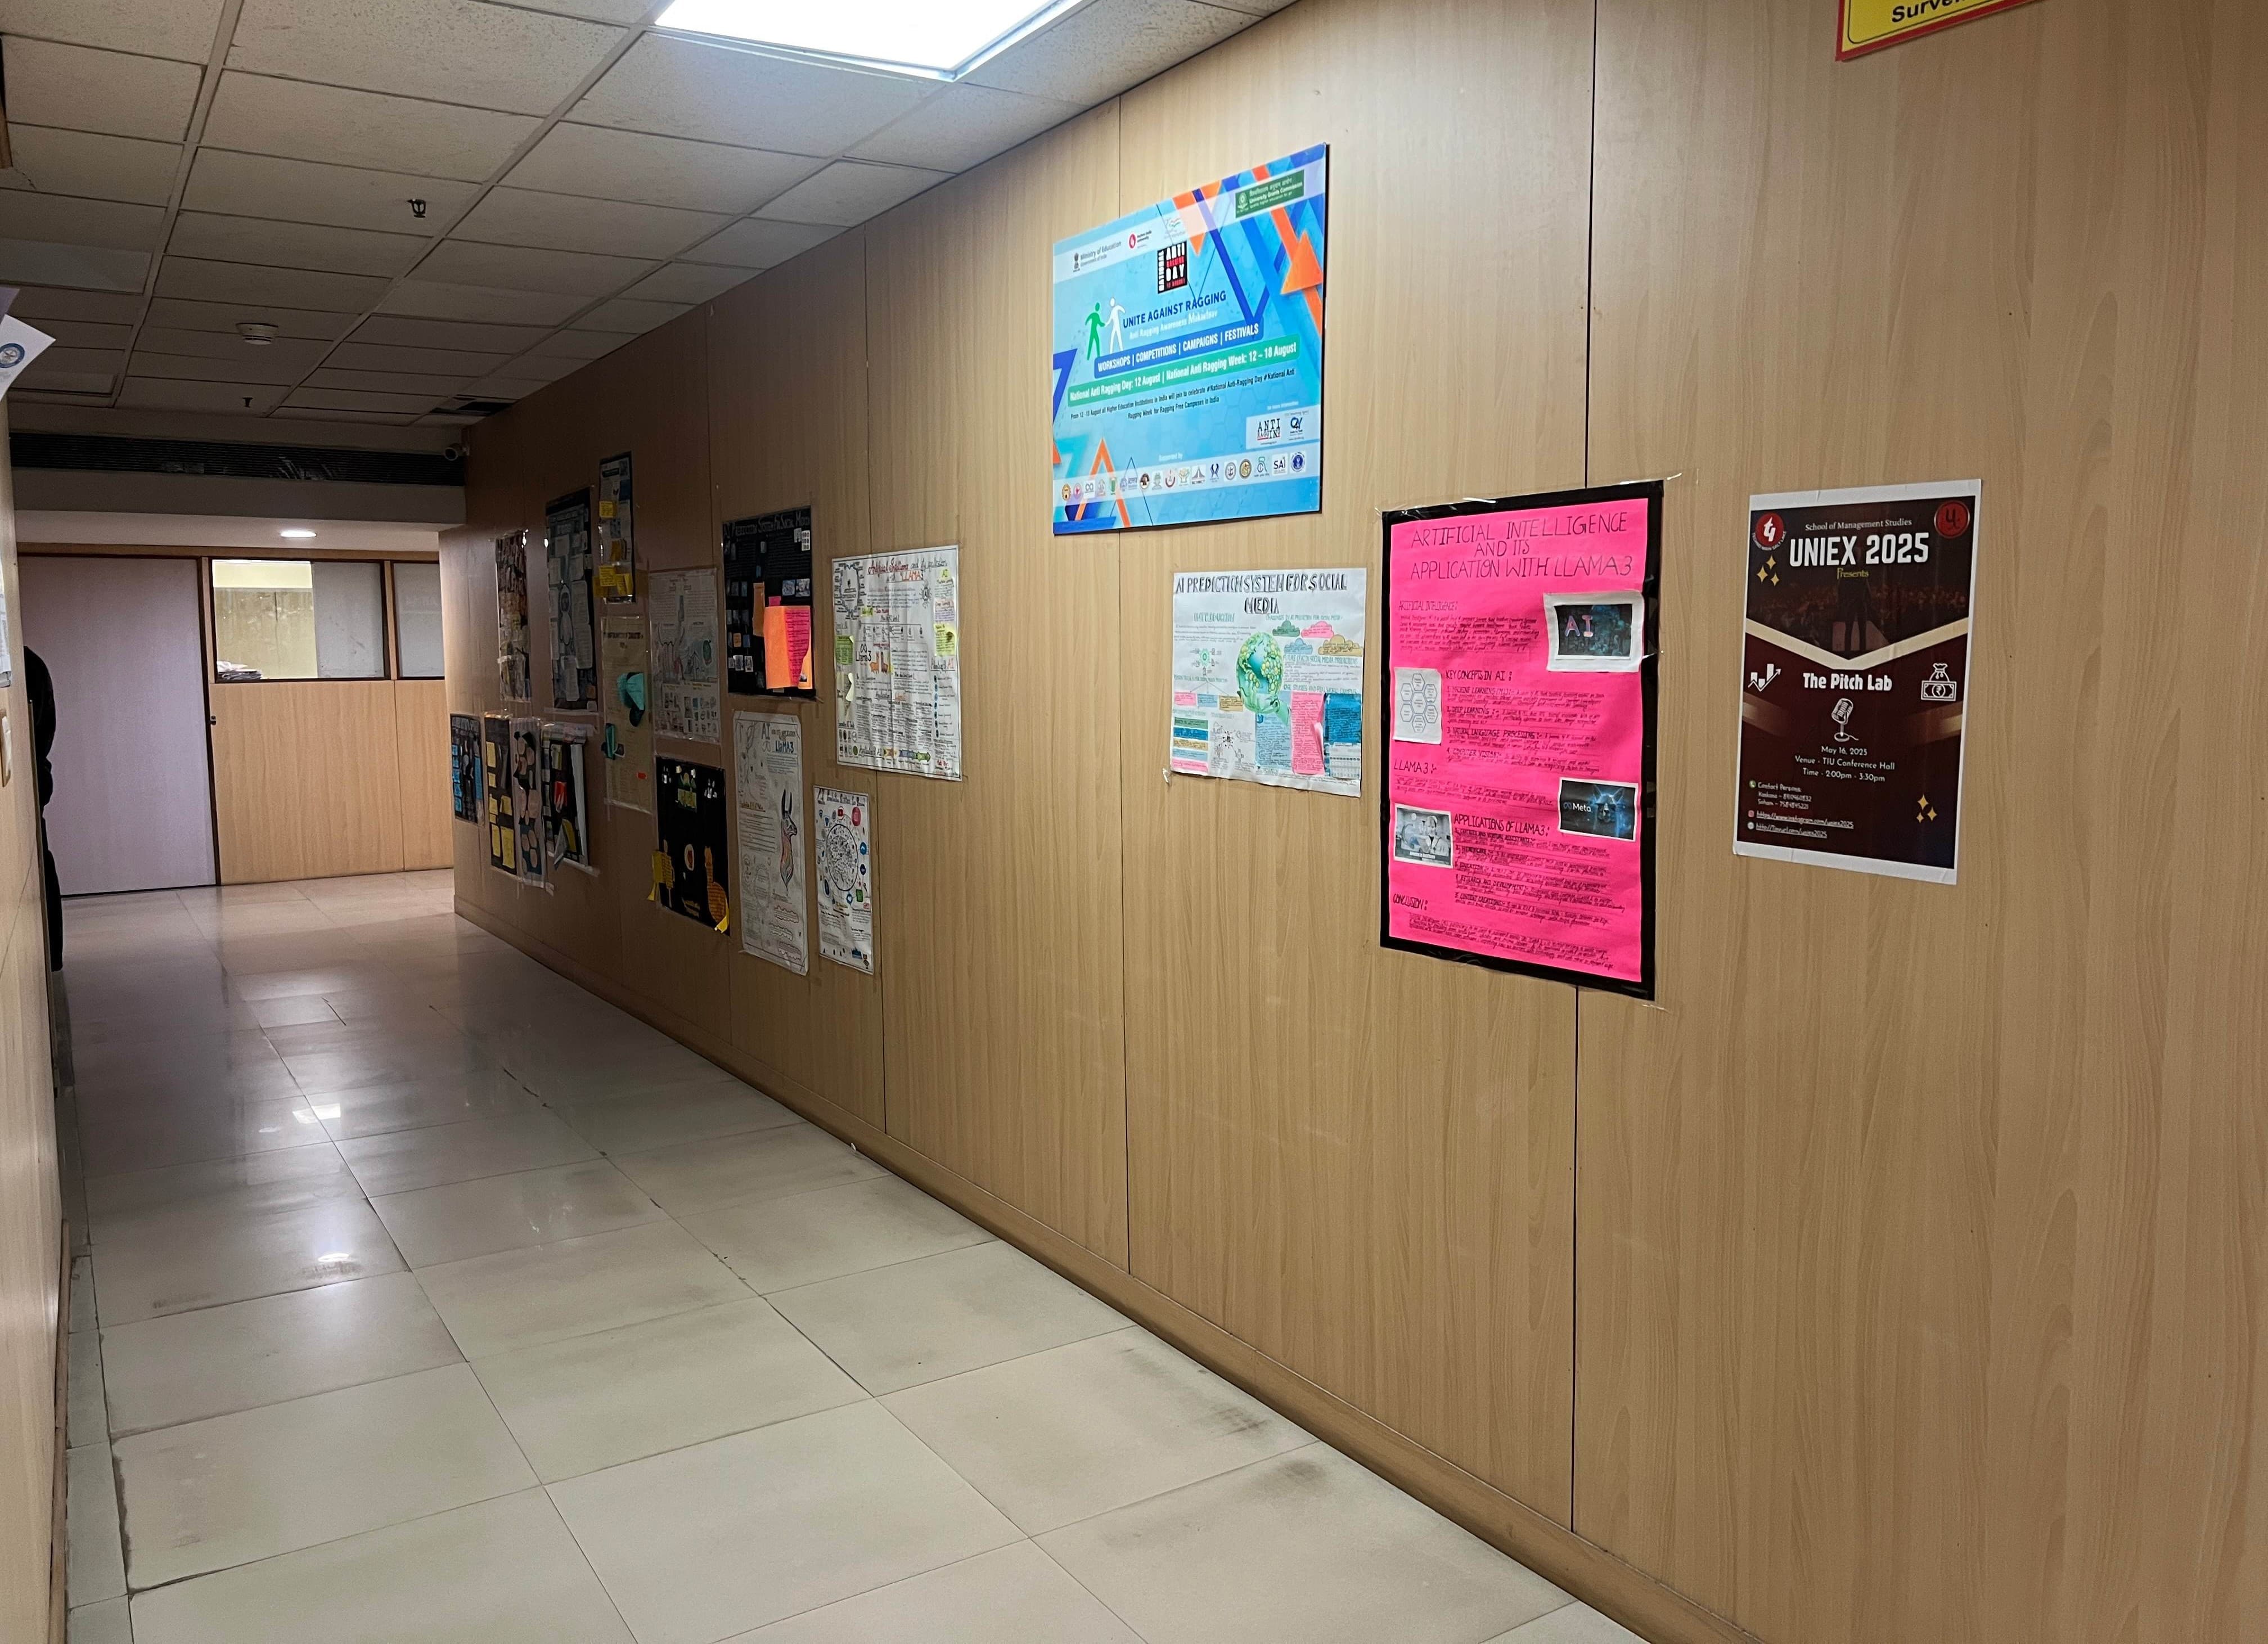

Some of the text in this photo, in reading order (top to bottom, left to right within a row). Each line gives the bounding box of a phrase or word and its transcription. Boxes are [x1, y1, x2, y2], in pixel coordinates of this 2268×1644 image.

[1081, 249, 1096, 260] Ministry
[1102, 241, 1122, 253] Education
[1166, 242, 1185, 260] ANTI
[1166, 263, 1185, 281] DAY
[1123, 290, 1226, 329] UNITE AGAINST RAGGING
[1098, 323, 1259, 372] WORKSHOPS COMPETITIONS CAMPAIGNS FESTIVALS
[1070, 341, 1297, 401] National Anti Ragging Day: 12 August National Anti Ragging Week: 12 18 August
[1091, 407, 1102, 416] August
[1118, 402, 1134, 411] Education
[1227, 377, 1253, 389] Anti-Ragging
[1254, 374, 1263, 384] Day
[1286, 367, 1295, 376] Anti
[1128, 411, 1142, 420] Ragging
[1160, 404, 1174, 413] Ragging
[1258, 418, 1280, 431] ANTI
[1411, 512, 1628, 548] ARTIFICIAL INTELLIGENCE
[1804, 517, 1912, 532] School of Management Studies
[1474, 539, 1530, 558] AND ITS
[1789, 535, 1857, 567] UNIEX
[1866, 532, 1930, 565] 2025
[1411, 558, 1500, 580] APPLICATION
[1506, 557, 1549, 578] WITH
[1837, 567, 1869, 580] Presents
[1176, 573, 1348, 594] AI PREDICTION SYSTEM FOR SOCIAL
[1244, 597, 1280, 615] MEDIA
[1564, 615, 1594, 637] AI
[1446, 670, 1456, 680] KEY
[1457, 669, 1483, 681] CONCEPTS
[1483, 670, 1492, 681] IN
[1803, 672, 1892, 692] The Pitch Lab
[1821, 745, 1868, 756] May 16, 2025
[1795, 755, 1816, 764] Venue
[1822, 758, 1835, 766] TIU
[1837, 758, 1877, 769] Conference
[1879, 761, 1895, 771] Hall
[1802, 767, 1819, 776] Time
[1758, 782, 1778, 790] Contact
[1573, 803, 1591, 813] Meta
[1454, 813, 1514, 832] APPLICATIONS OF
